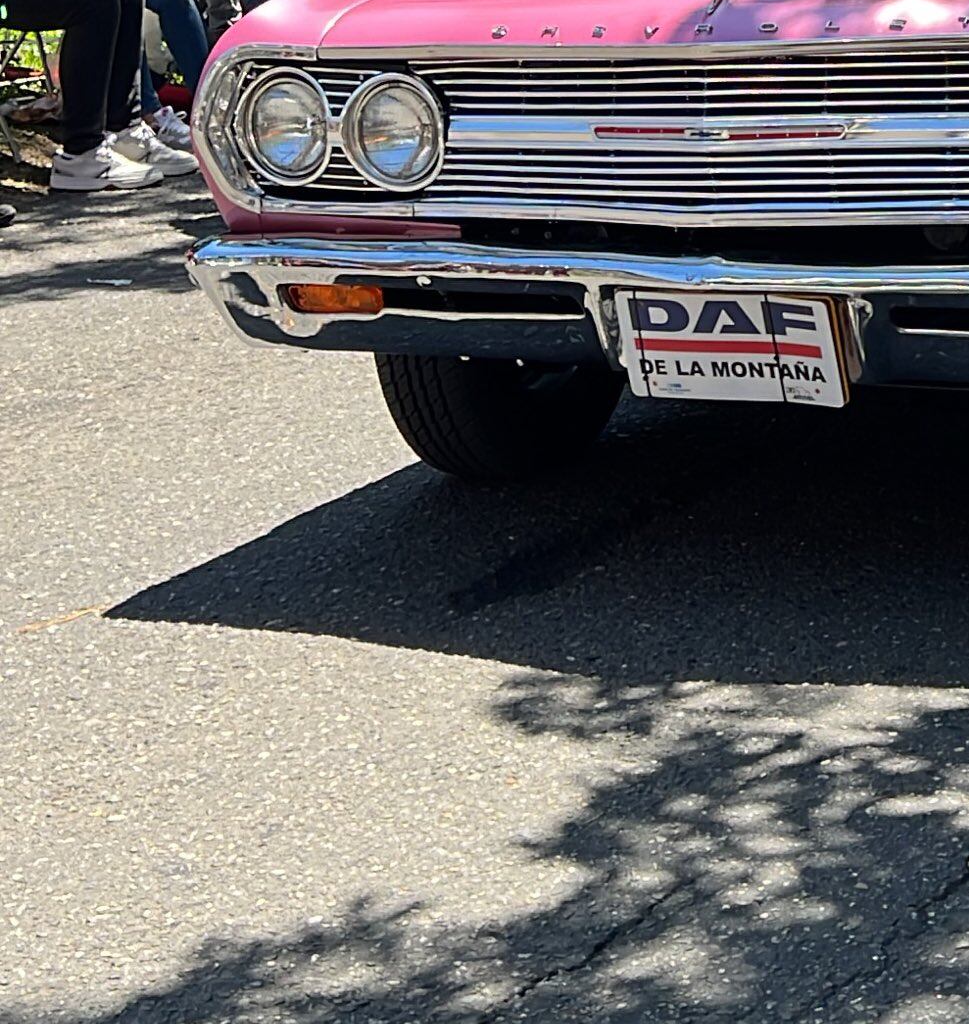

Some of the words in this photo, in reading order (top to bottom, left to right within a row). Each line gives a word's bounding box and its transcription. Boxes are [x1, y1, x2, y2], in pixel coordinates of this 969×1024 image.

[627, 298, 817, 336] DAF
[640, 359, 668, 376] DE
[676, 360, 705, 377] LA
[712, 360, 827, 383] MONTAÑA
